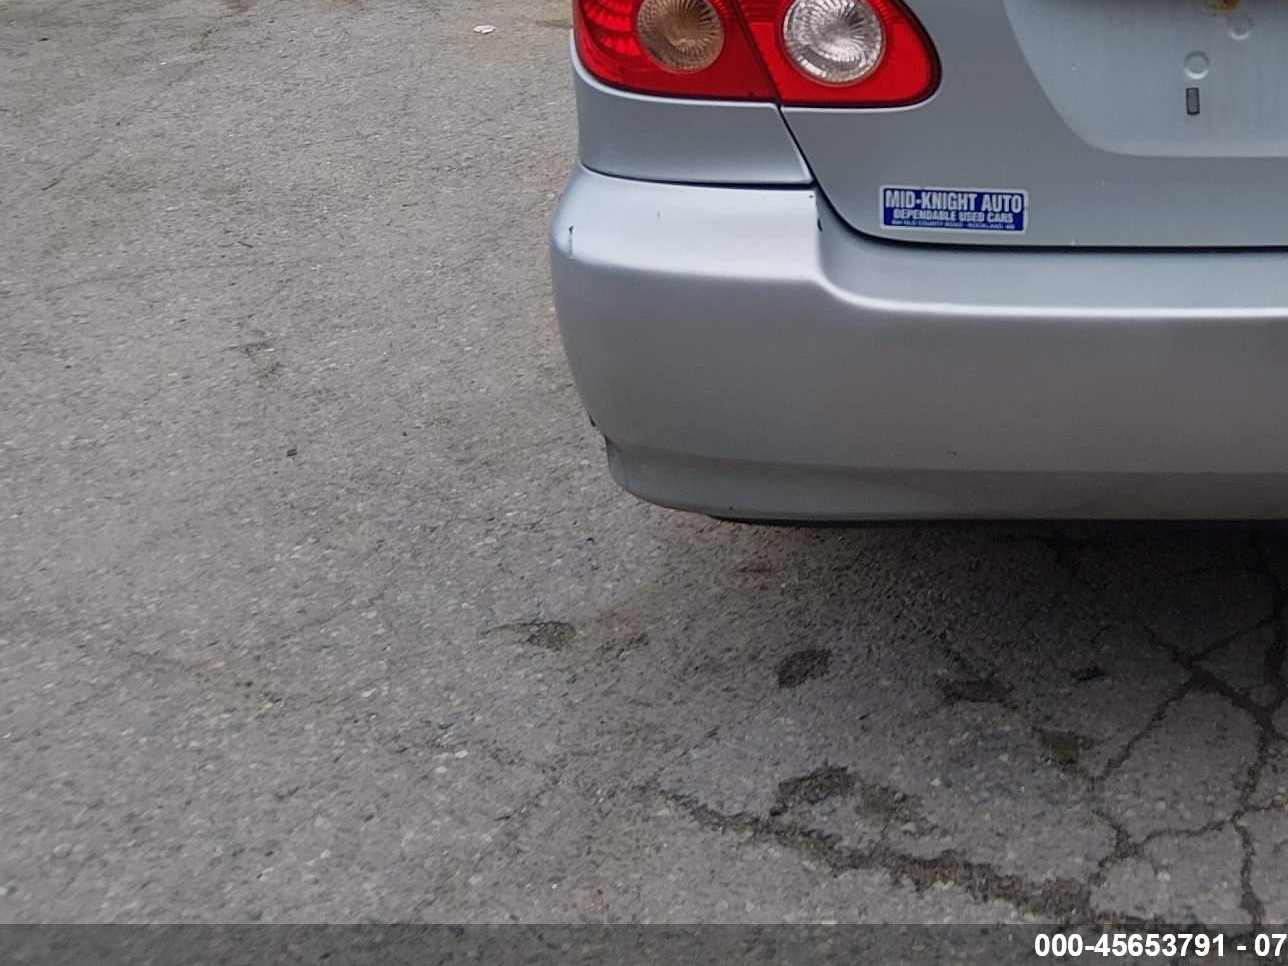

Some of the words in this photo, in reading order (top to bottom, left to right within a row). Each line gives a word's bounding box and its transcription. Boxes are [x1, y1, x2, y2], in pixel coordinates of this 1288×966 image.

[885, 189, 977, 211] MID-KNIGHT
[981, 194, 1022, 213] AUTO
[893, 208, 957, 221] DEPENDABLE
[958, 211, 984, 222] USED
[986, 212, 1014, 223] CARS
